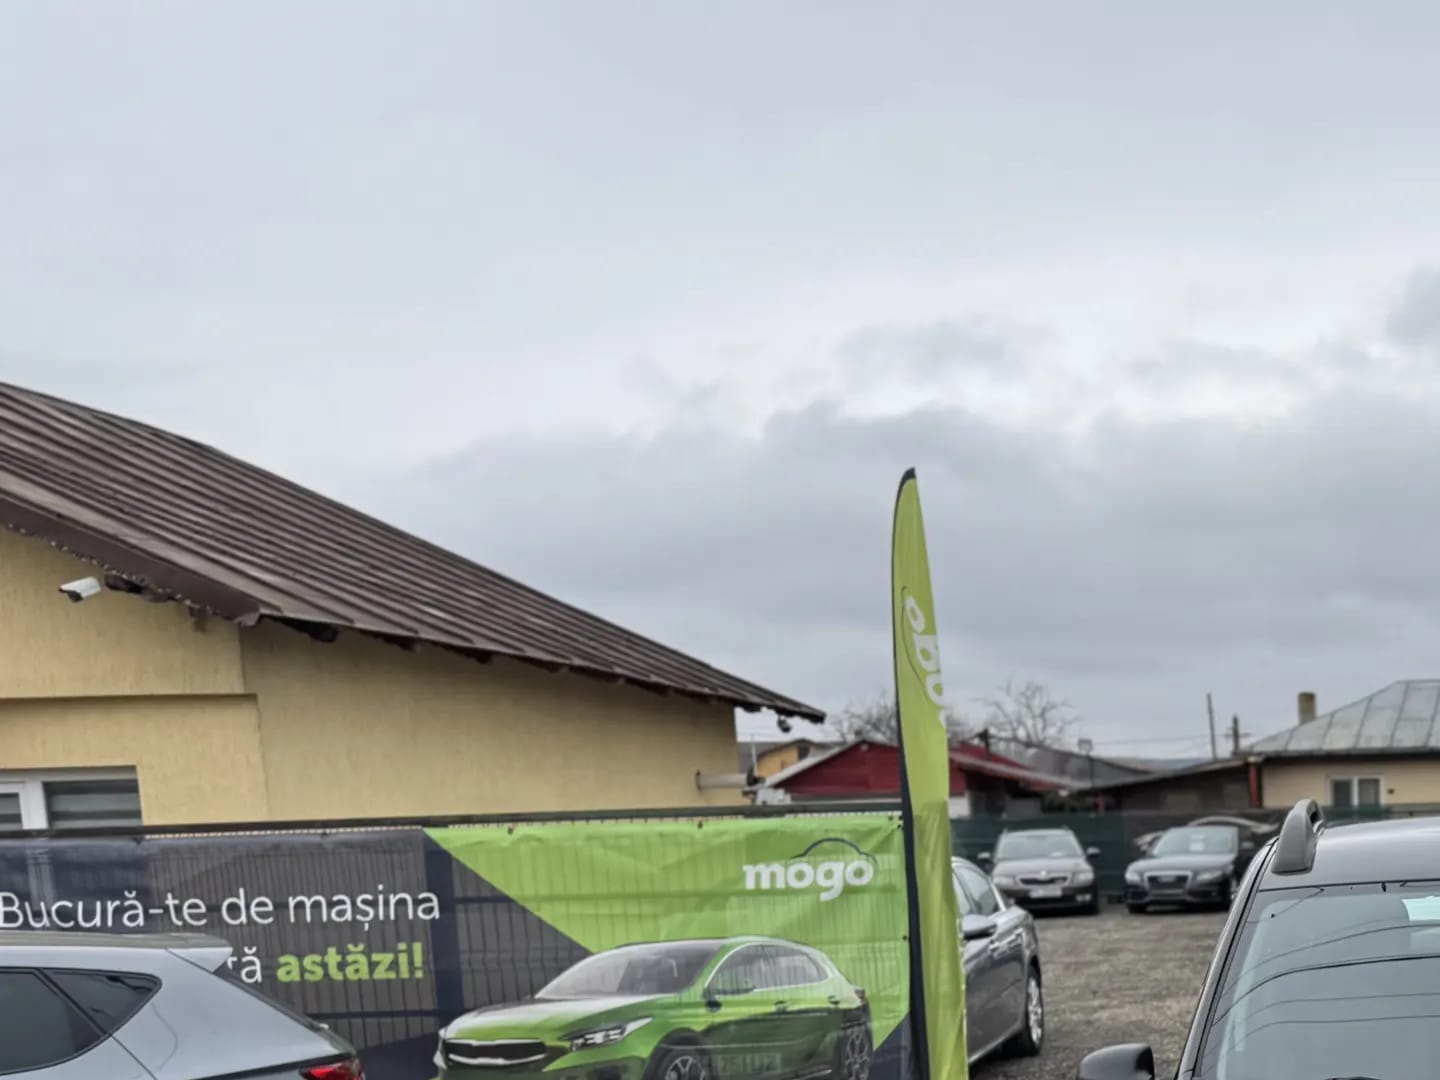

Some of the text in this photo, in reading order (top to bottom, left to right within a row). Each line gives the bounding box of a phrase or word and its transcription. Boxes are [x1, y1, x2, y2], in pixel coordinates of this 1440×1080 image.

[905, 595, 944, 732] ogo
[742, 860, 874, 902] mogo
[0, 885, 441, 931] Bucură-te de mașina
[276, 942, 424, 983] astăzi!
